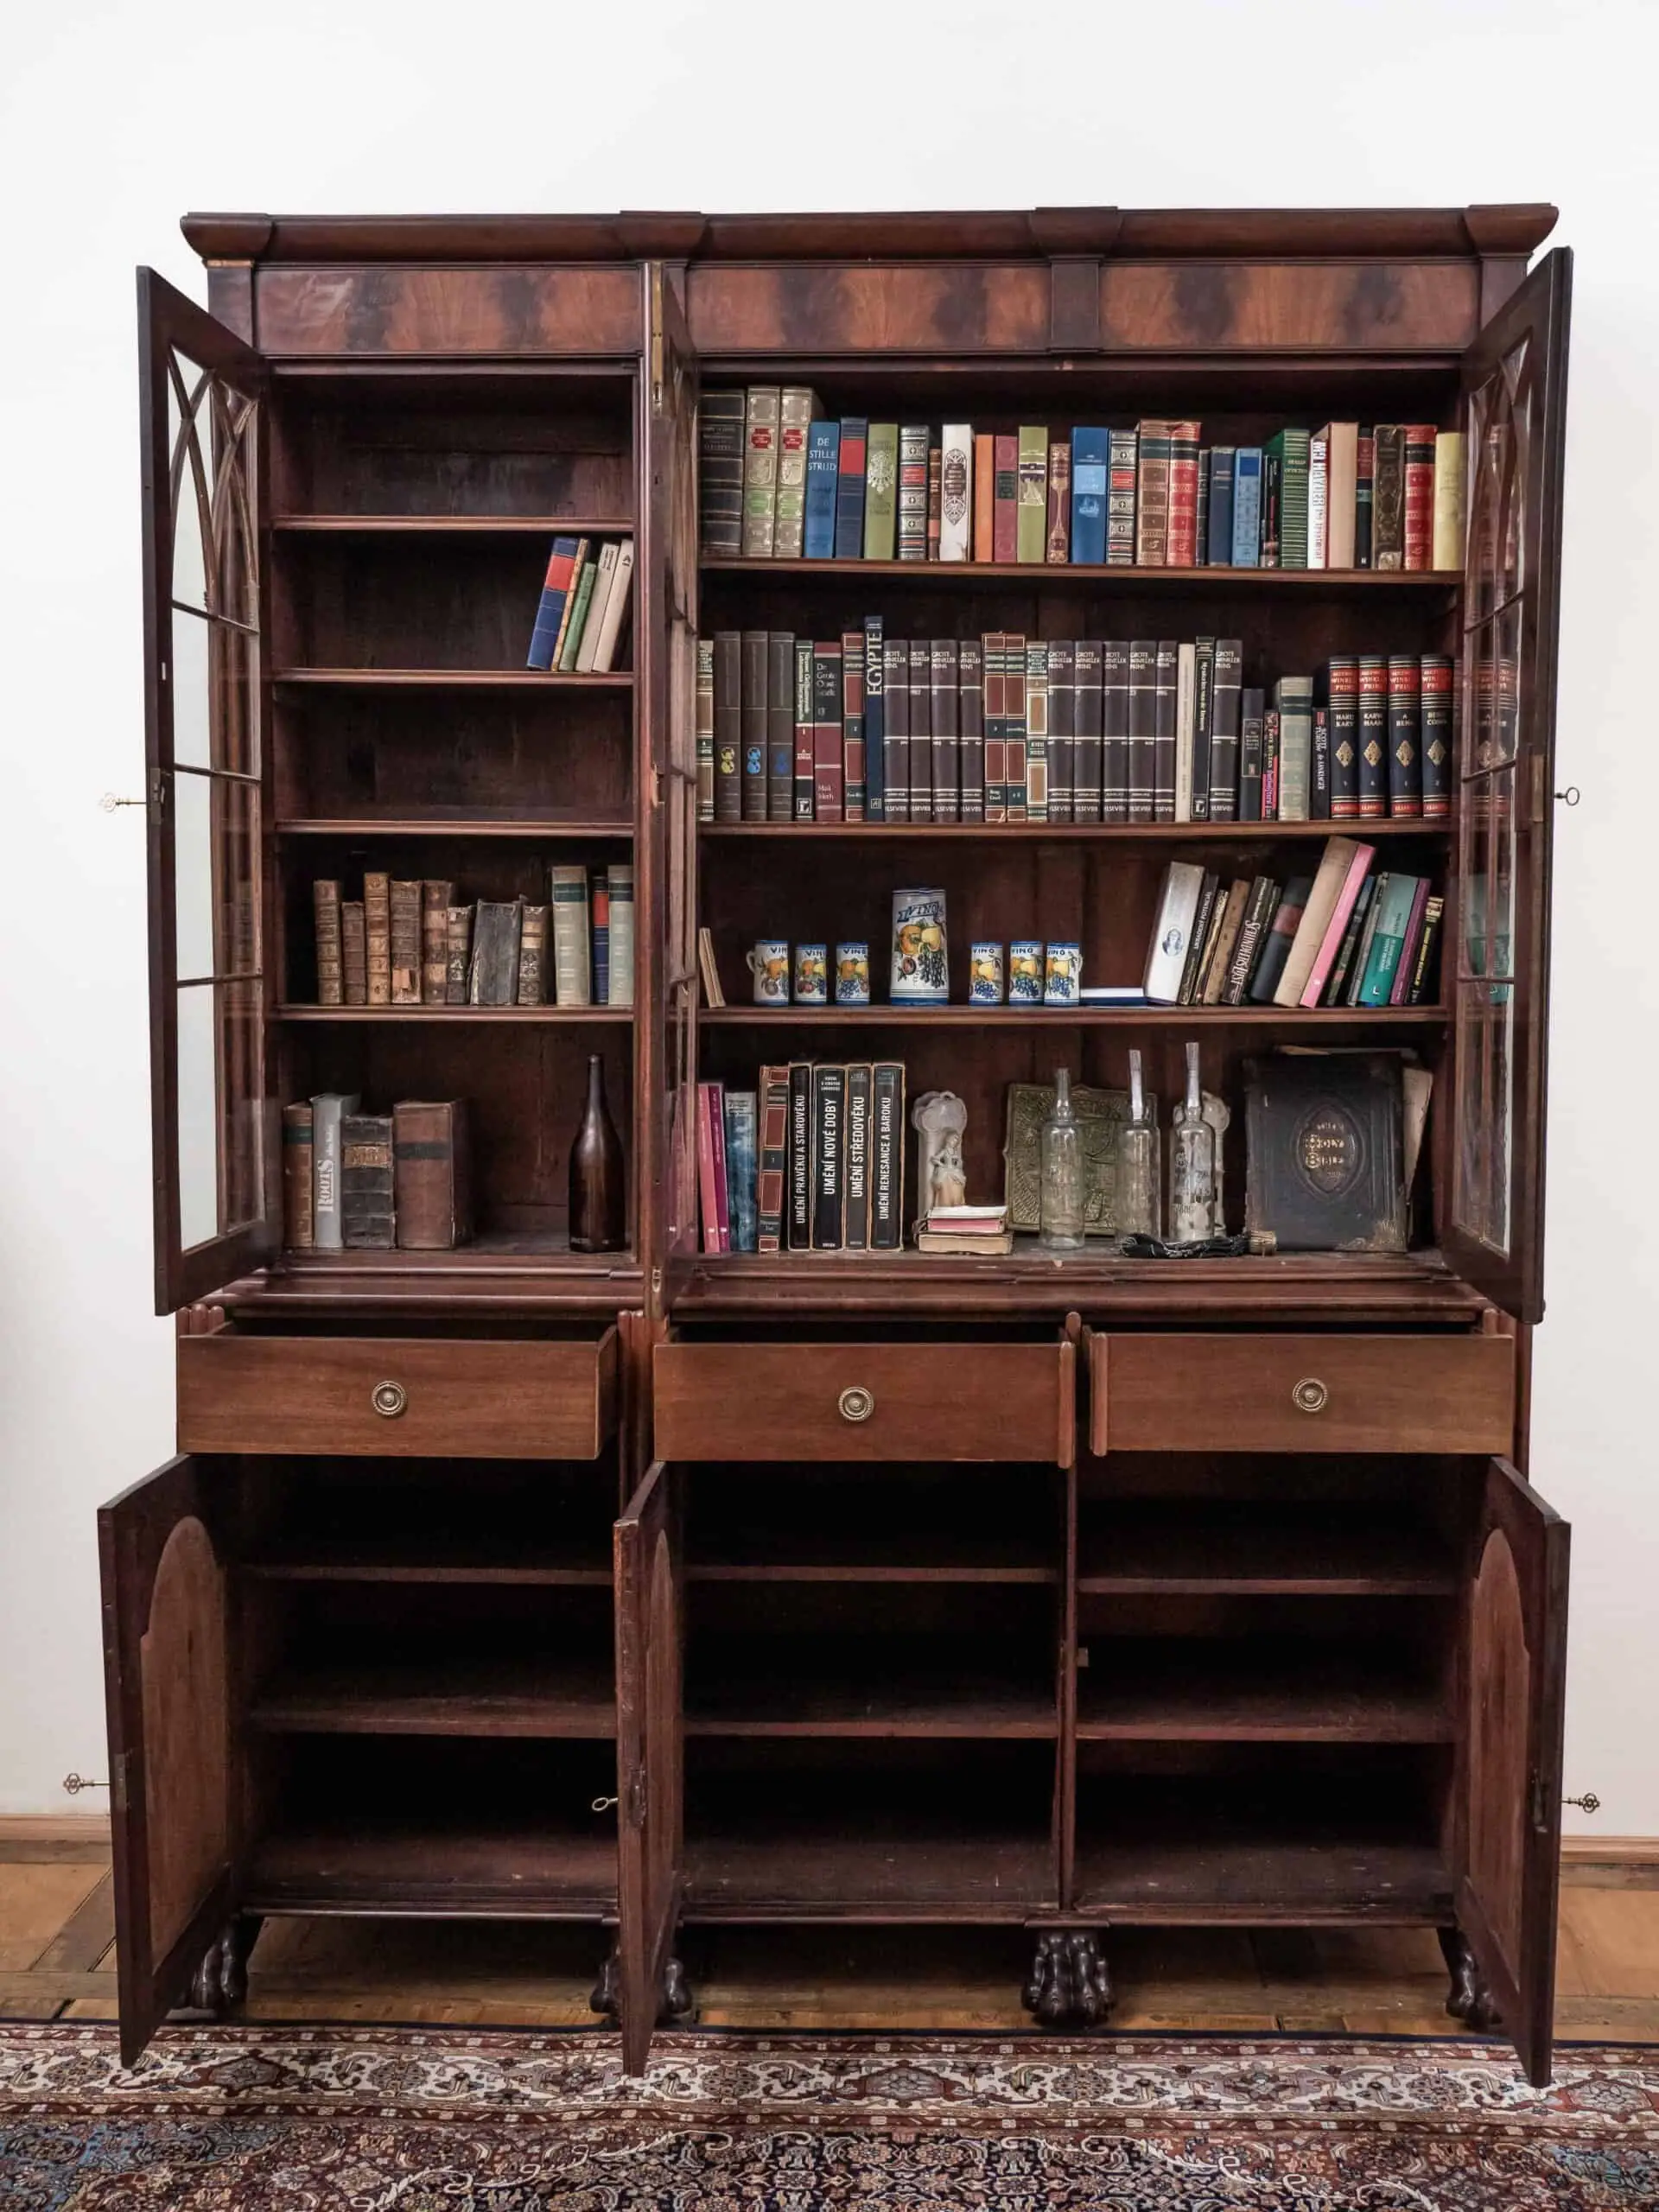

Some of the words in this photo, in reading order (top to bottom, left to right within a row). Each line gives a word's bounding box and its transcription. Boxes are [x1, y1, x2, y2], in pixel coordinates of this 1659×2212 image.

[809, 449, 836, 459] STILLE
[817, 436, 830, 446] DE
[808, 462, 836, 471] STRIJD
[867, 632, 882, 695] EGYPTE
[793, 1095, 805, 1145] STAROVĚKU
[823, 1098, 837, 1128] DOBY
[880, 1096, 892, 1133] BAROKU
[822, 1130, 836, 1158] NOVÉ
[849, 1096, 865, 1163] STŘEDOVĚKU
[1305, 1134, 1345, 1150] HOLY
[794, 1154, 806, 1194] PRAVĚKU
[822, 1160, 836, 1195] UMĚNÍ
[880, 1141, 891, 1191] RENESANCE
[849, 1166, 864, 1198] UMĚNÍ
[793, 1196, 806, 1224] UMĚNÍ
[877, 1192, 890, 1220] UMĚNÍ
